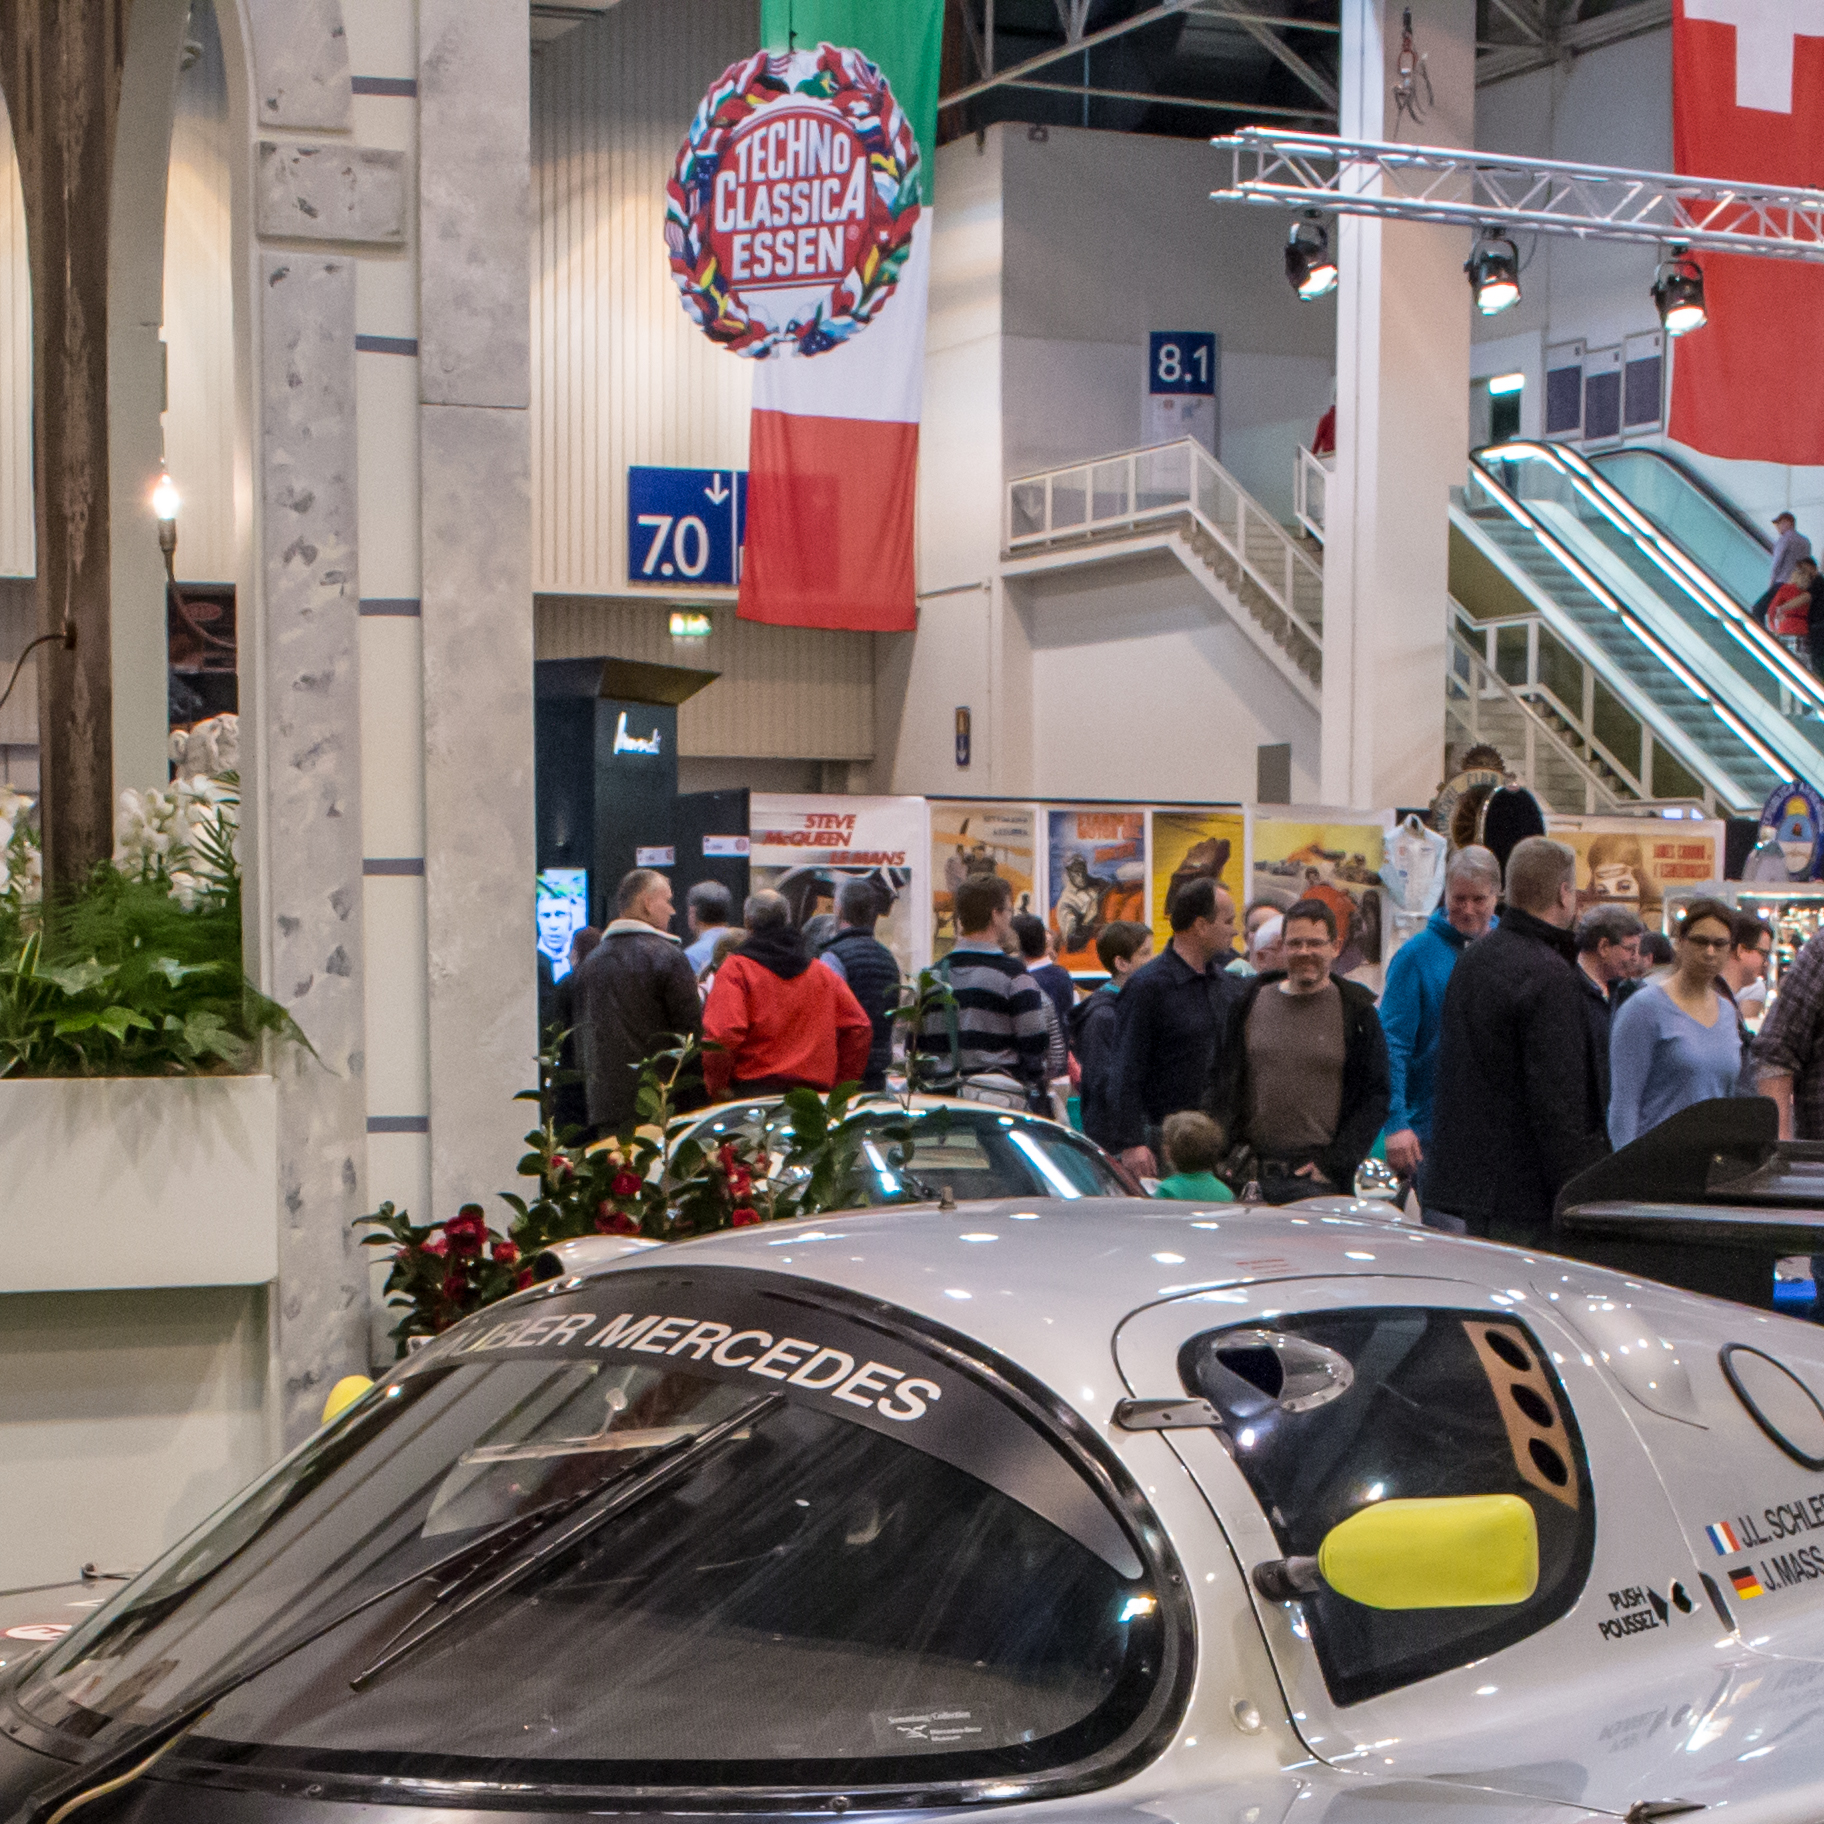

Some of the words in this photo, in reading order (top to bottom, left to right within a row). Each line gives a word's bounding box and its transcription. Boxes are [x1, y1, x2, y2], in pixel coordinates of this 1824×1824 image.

[735, 117, 852, 180] TECHNO
[714, 171, 867, 234] CLASSICA
[731, 224, 846, 281] ESSEN
[1156, 342, 1209, 385] 8.1
[636, 514, 710, 578] 7.0
[803, 813, 857, 830] STEVE
[848, 851, 906, 865] MANS
[585, 1312, 942, 1422] MERCEDES
[1607, 1585, 1648, 1612] PUSH
[1598, 1609, 1660, 1641] POUSSEZ
